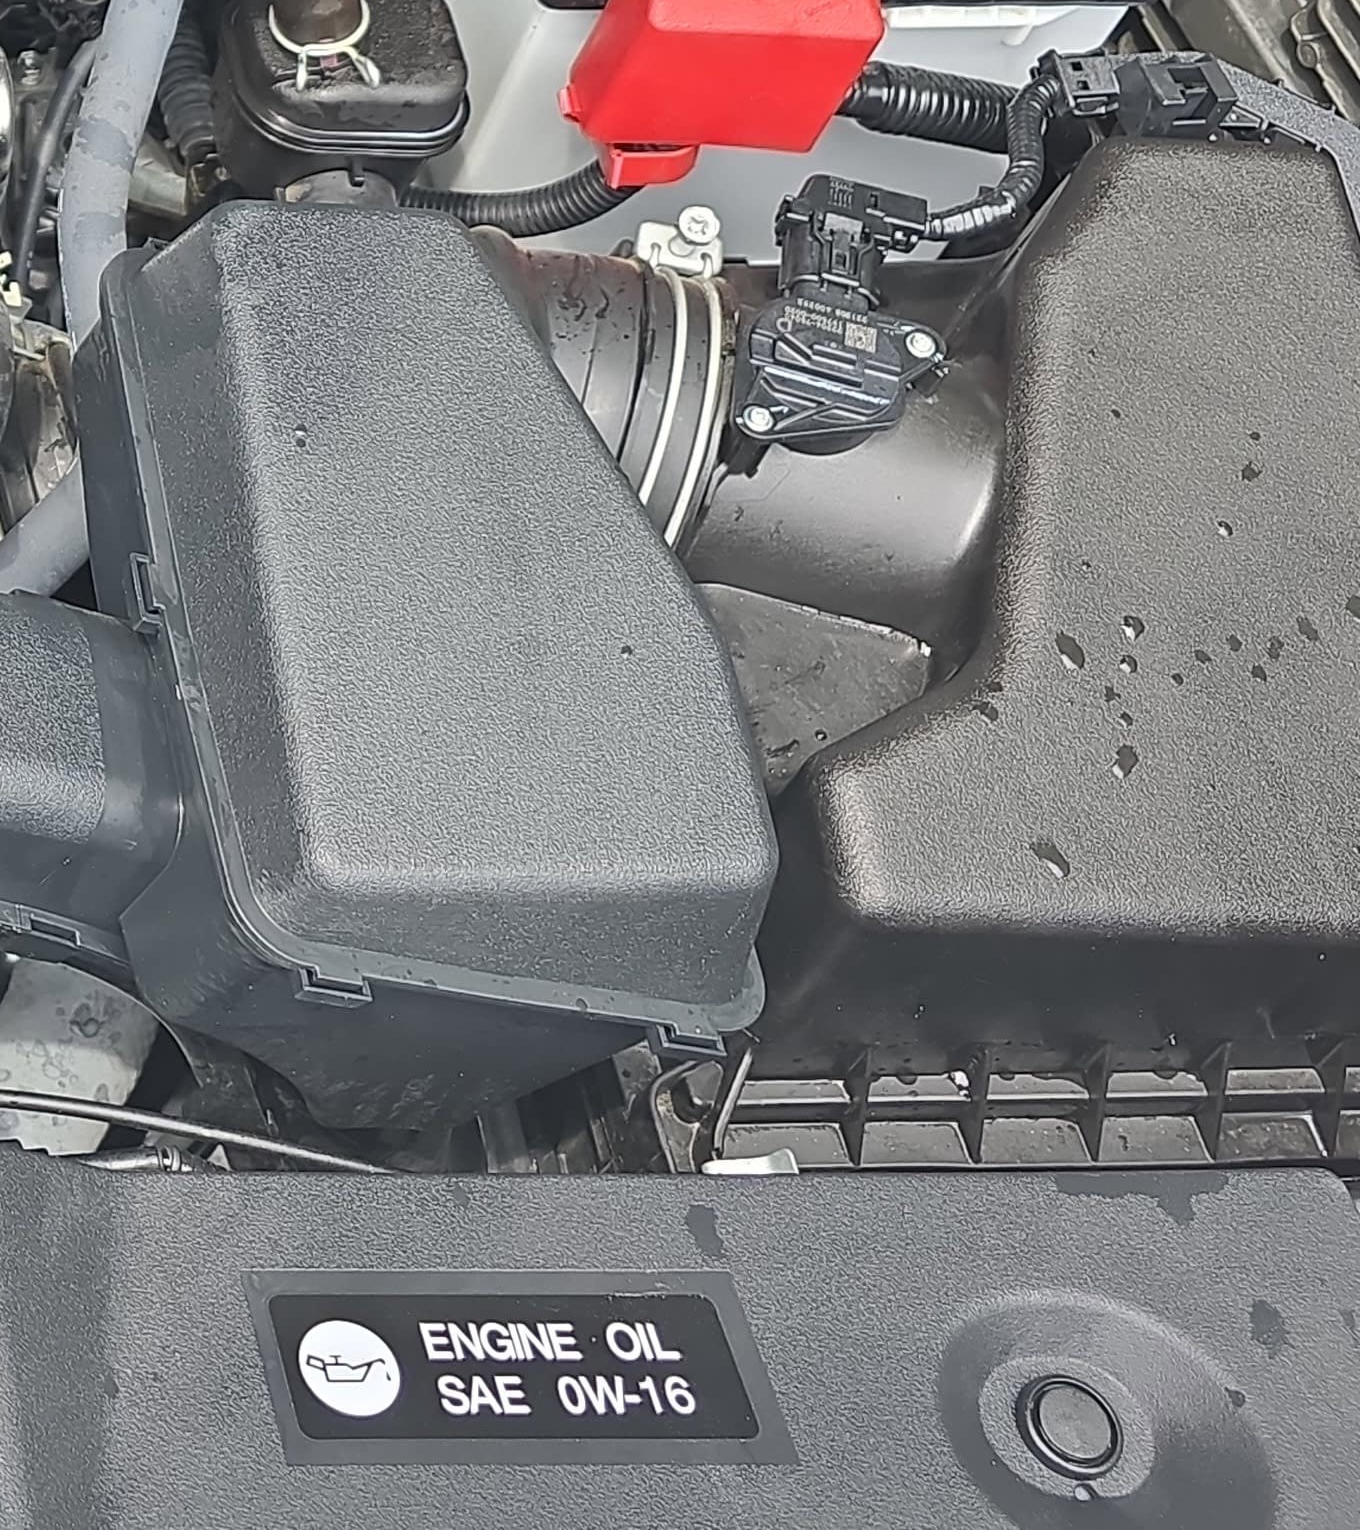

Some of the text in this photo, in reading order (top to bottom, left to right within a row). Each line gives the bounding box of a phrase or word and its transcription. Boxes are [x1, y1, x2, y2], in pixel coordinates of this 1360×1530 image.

[419, 1322, 683, 1361] ENGINE OIL
[436, 1375, 696, 1415] SAE 0W-16
